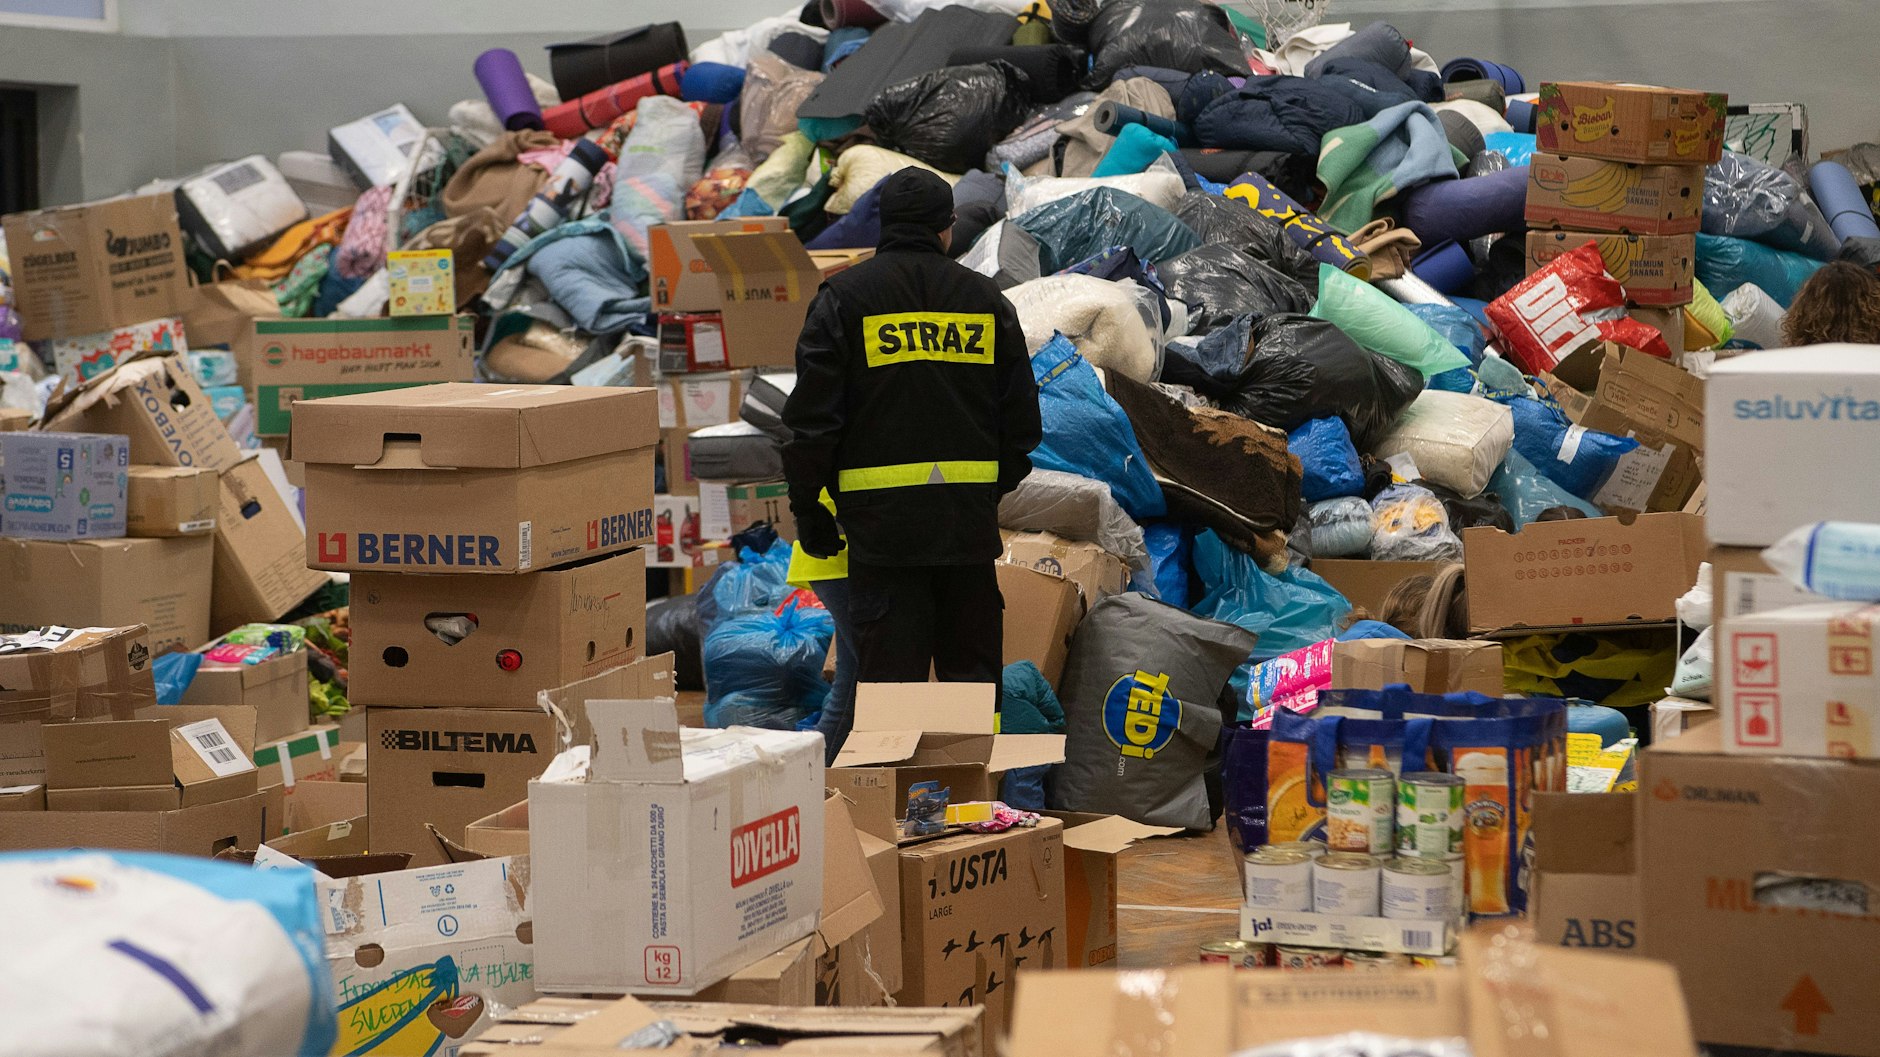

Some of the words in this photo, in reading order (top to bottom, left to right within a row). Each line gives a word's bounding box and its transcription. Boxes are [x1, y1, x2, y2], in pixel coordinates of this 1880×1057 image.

[1626, 187, 1660, 198] PREMIUM
[1626, 196, 1659, 207] BANANAS
[1630, 260, 1664, 268] PREMIUM
[1630, 269, 1664, 278] BANANAS
[291, 342, 432, 364] hagebaumarkt
[601, 508, 654, 547] BERNER
[1558, 538, 1586, 546] PACKER
[358, 533, 502, 566] BERNER
[399, 730, 538, 754] BILTEMA
[1116, 756, 1126, 777] .com
[650, 825, 657, 835] DA
[732, 813, 798, 880] DIVELLA
[658, 860, 665, 868] DI
[660, 902, 666, 911] DI
[929, 904, 953, 920] LARGE
[1252, 917, 1273, 936] ja!
[1560, 918, 1636, 949] ABS
[654, 950, 671, 964] kg
[656, 967, 671, 979] 12
